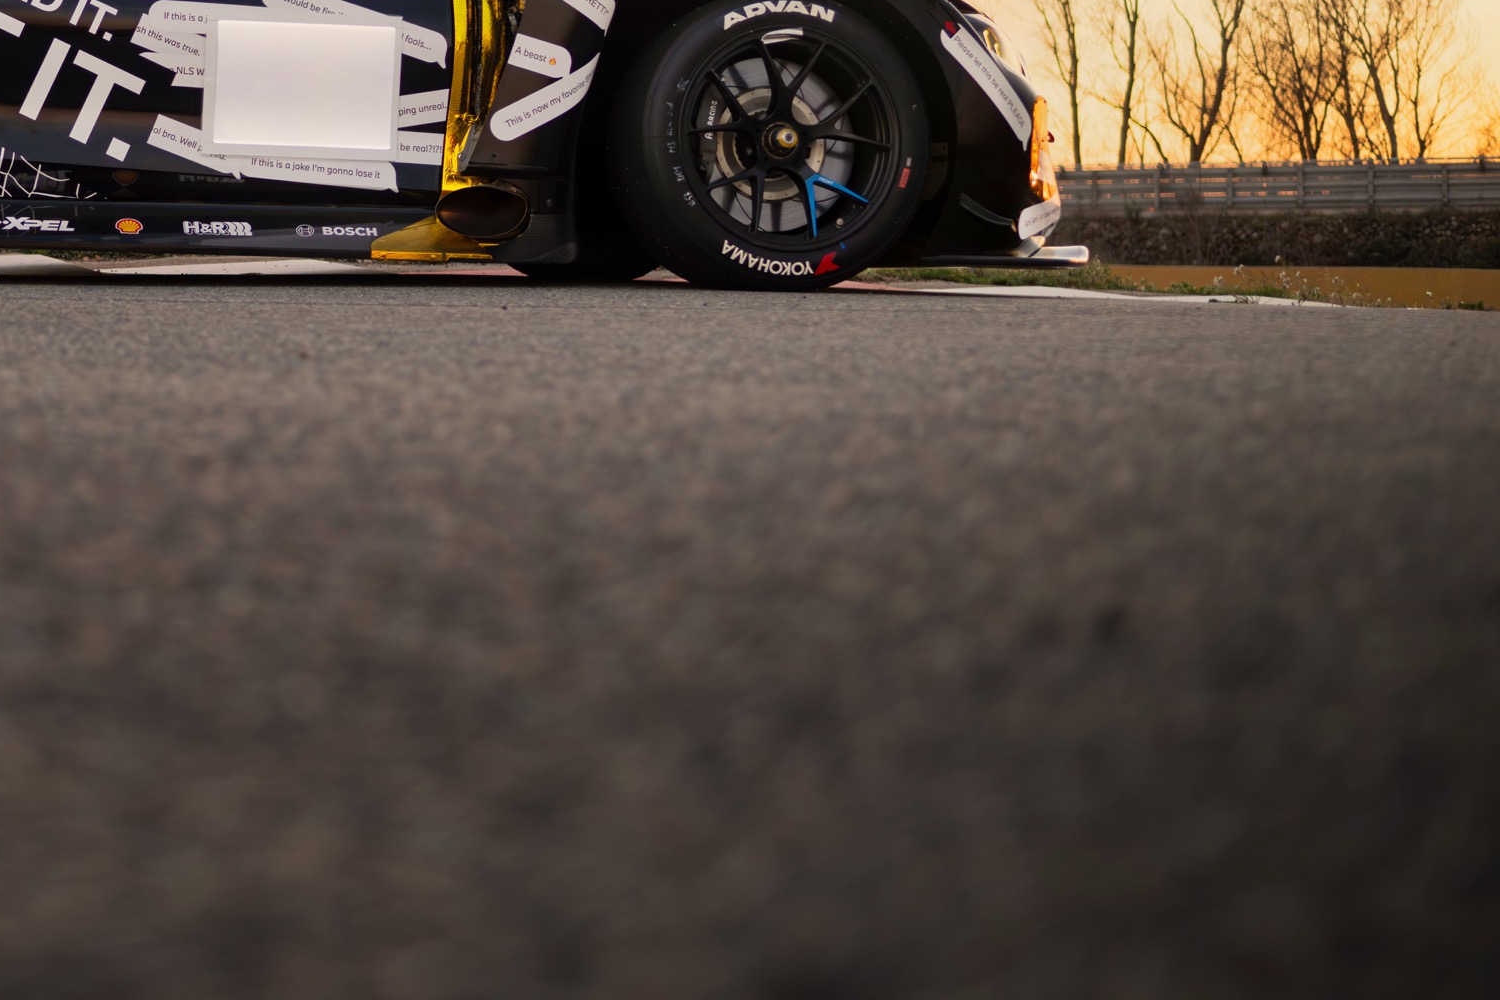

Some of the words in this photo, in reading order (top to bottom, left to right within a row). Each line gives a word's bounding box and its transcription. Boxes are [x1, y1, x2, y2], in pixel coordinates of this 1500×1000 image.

[164, 11, 170, 20] If
[171, 12, 187, 21] this
[188, 13, 196, 22] is
[310, 3, 321, 13] be
[724, 0, 835, 30] ADVAN
[147, 29, 163, 41] this
[164, 37, 181, 48] was
[182, 43, 201, 56] true.
[405, 33, 432, 51] fools...
[515, 46, 521, 54] A
[523, 48, 548, 63] beast
[176, 66, 195, 76] NLS
[954, 35, 974, 59] Please
[973, 57, 982, 69] let
[981, 66, 992, 80] this
[991, 78, 999, 89] be
[998, 87, 1008, 102] real
[1007, 99, 1026, 129] PLEASE
[19, 37, 146, 162] IT.
[419, 101, 447, 113] unreal.
[505, 115, 523, 128] This
[522, 111, 532, 119] is
[531, 101, 550, 115] now
[549, 96, 561, 106] my
[561, 81, 585, 99] favorite
[707, 100, 718, 126] RACING
[162, 130, 177, 142] bro.
[180, 136, 198, 149] Well
[400, 142, 411, 152] be
[251, 157, 258, 165] If
[258, 159, 274, 168] this
[275, 160, 283, 168] is
[292, 161, 311, 172] joke
[312, 163, 325, 173] I'm
[327, 166, 354, 176] gonna
[355, 168, 373, 178] lose
[374, 170, 381, 179] it
[1, 216, 76, 232] XPEL
[322, 226, 378, 237] BOSCH
[721, 239, 814, 276] YOKOHAMA
